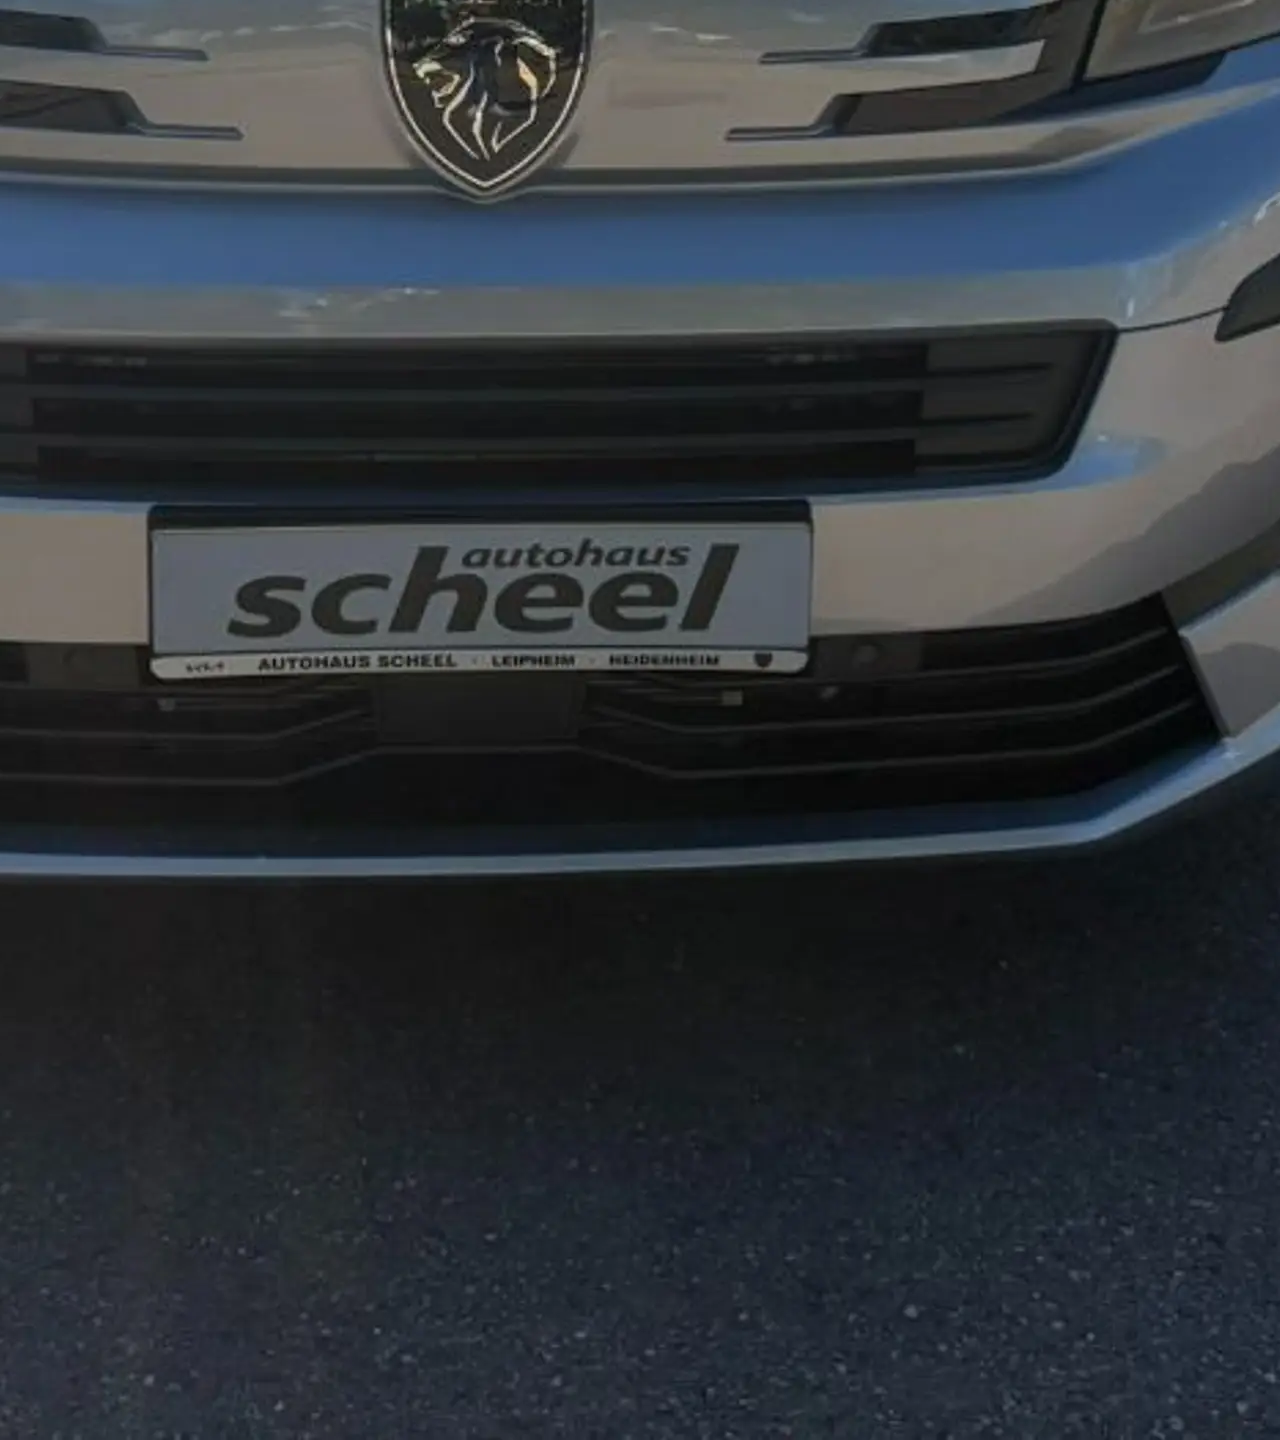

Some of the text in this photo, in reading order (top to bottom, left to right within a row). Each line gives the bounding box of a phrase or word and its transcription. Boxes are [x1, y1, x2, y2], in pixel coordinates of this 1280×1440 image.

[461, 538, 691, 569] autohaus
[226, 544, 740, 637] scheel
[257, 653, 720, 671] AUTOHAUS SCHEEL LEIPHEIM HEIDENHEIM
